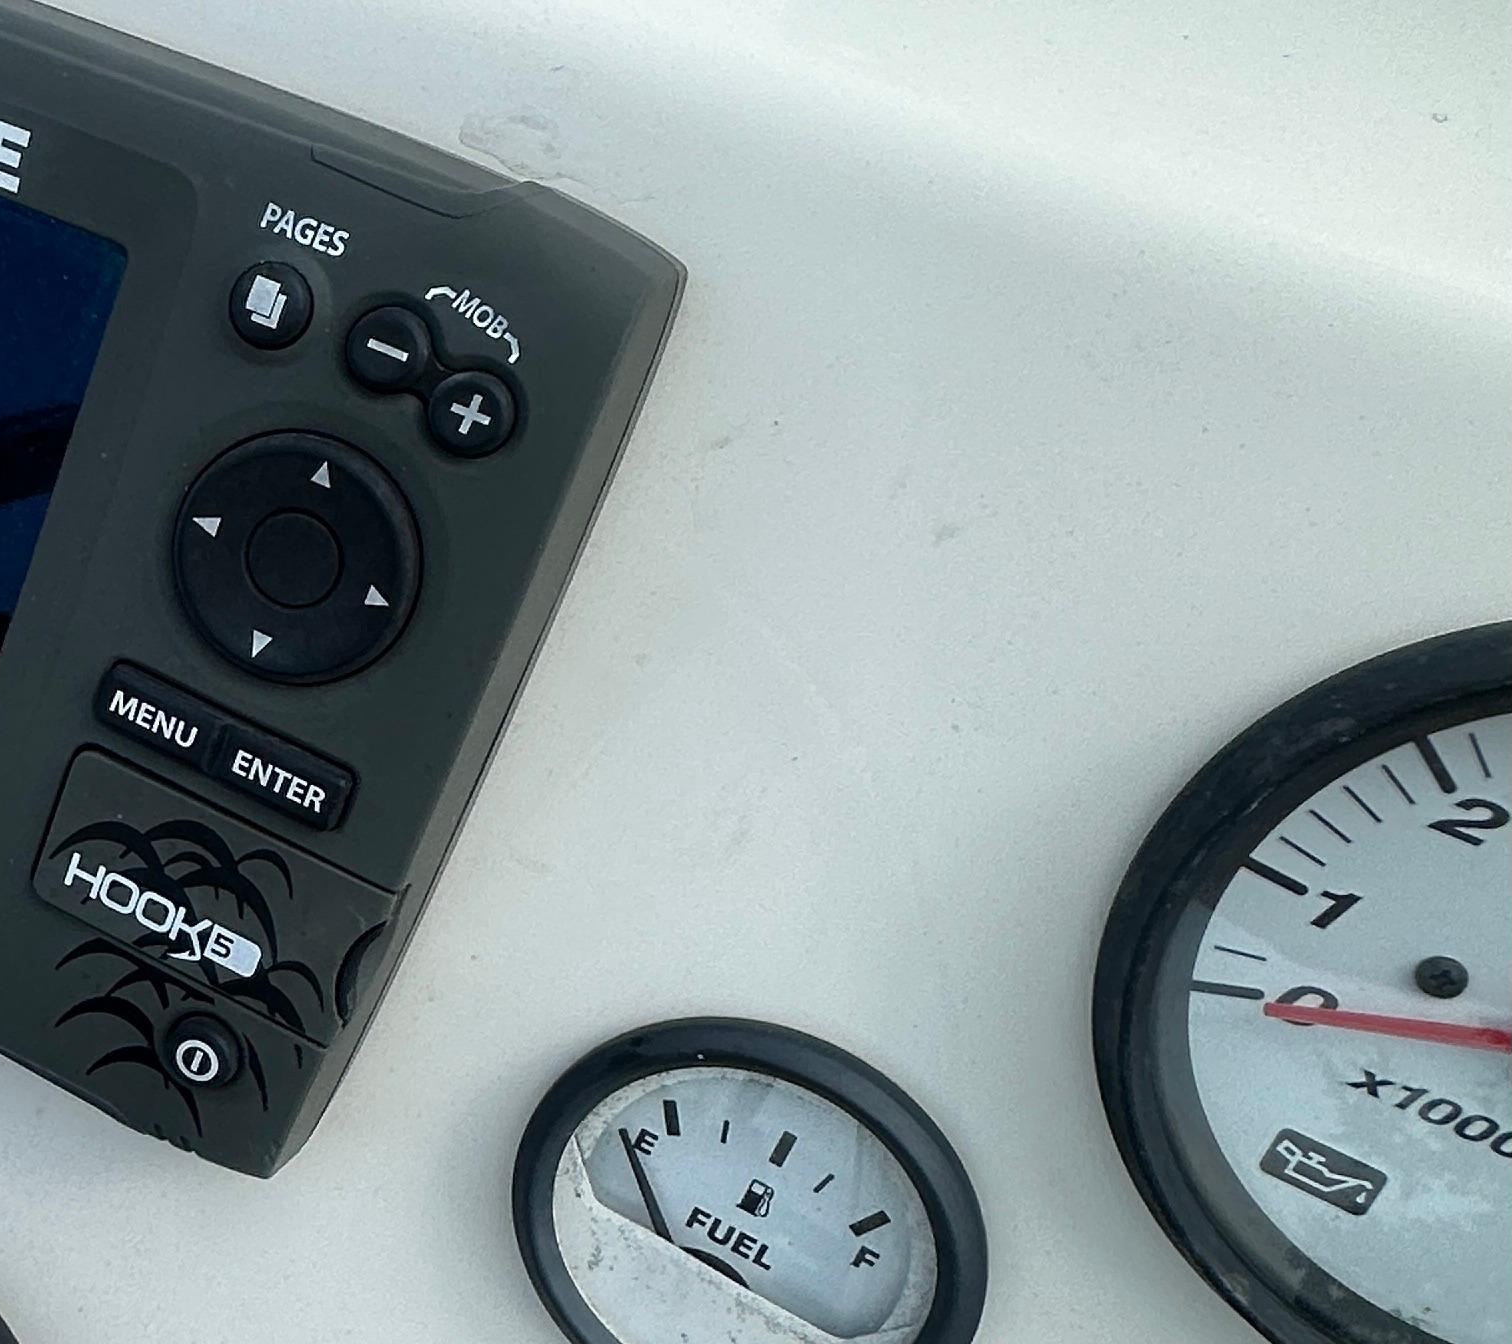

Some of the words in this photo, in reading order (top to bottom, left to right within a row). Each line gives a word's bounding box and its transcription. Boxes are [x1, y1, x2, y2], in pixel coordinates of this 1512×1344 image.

[259, 201, 351, 257] PAGES
[451, 287, 510, 339] MOB
[108, 689, 199, 748] MENU
[231, 749, 327, 813] ENTER
[1427, 797, 1511, 846] 2
[1310, 889, 1363, 929] 1
[632, 1128, 659, 1156] E
[684, 1206, 772, 1271] FUEL
[852, 1245, 881, 1269] F
